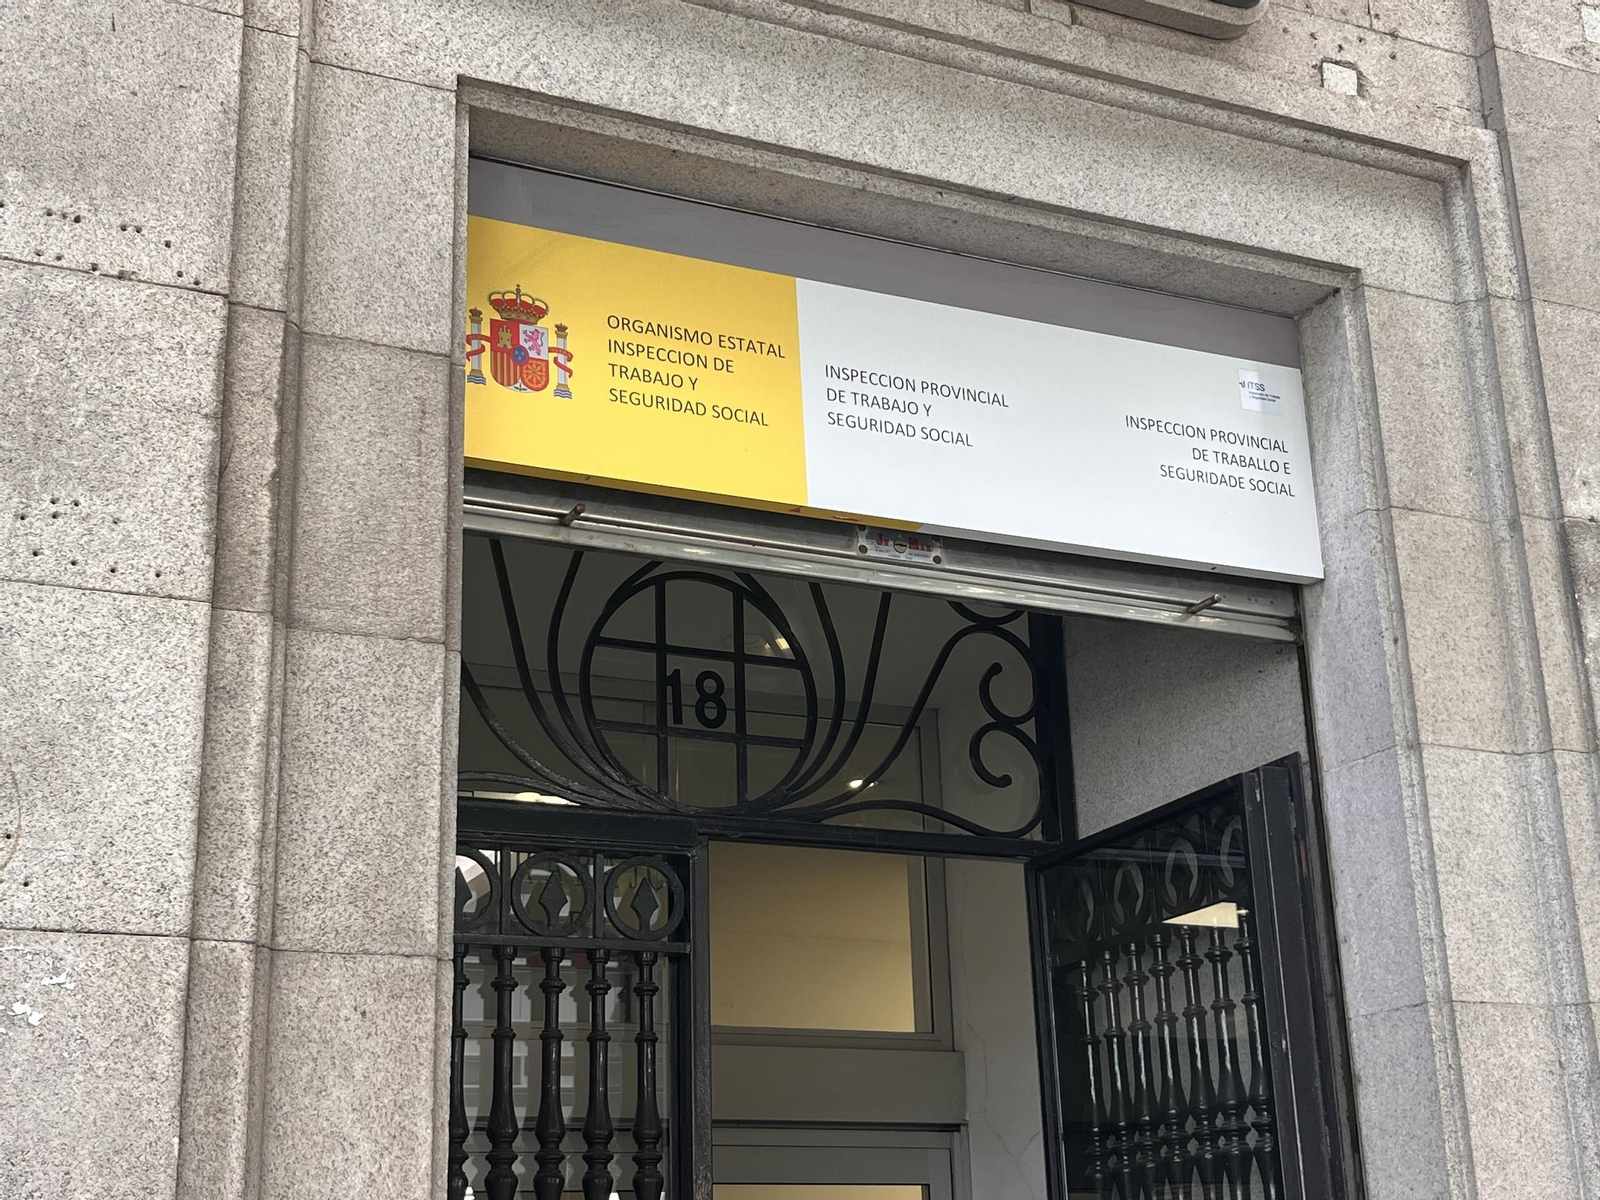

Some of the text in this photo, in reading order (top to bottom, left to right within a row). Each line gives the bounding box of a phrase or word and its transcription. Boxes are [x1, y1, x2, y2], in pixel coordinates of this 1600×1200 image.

[607, 314, 786, 359] ORGANISMO ESTATAL
[608, 338, 735, 374] INSPECCION DE
[607, 362, 699, 391] TRABAJO Y
[825, 364, 1010, 408] INSPECCION PROVINCIAL
[609, 387, 769, 427] SEGURIDAD SOCIAL
[826, 387, 932, 418] DE TRABAJO Y
[827, 411, 974, 448] SEGURIDAD SOCIAL
[1125, 414, 1289, 454] INSPECCION PROVINCIAL
[1192, 447, 1291, 475] DE TRABALLO E
[1159, 464, 1296, 498] SEGURIDADE SOCIAL
[664, 668, 727, 729] 18
